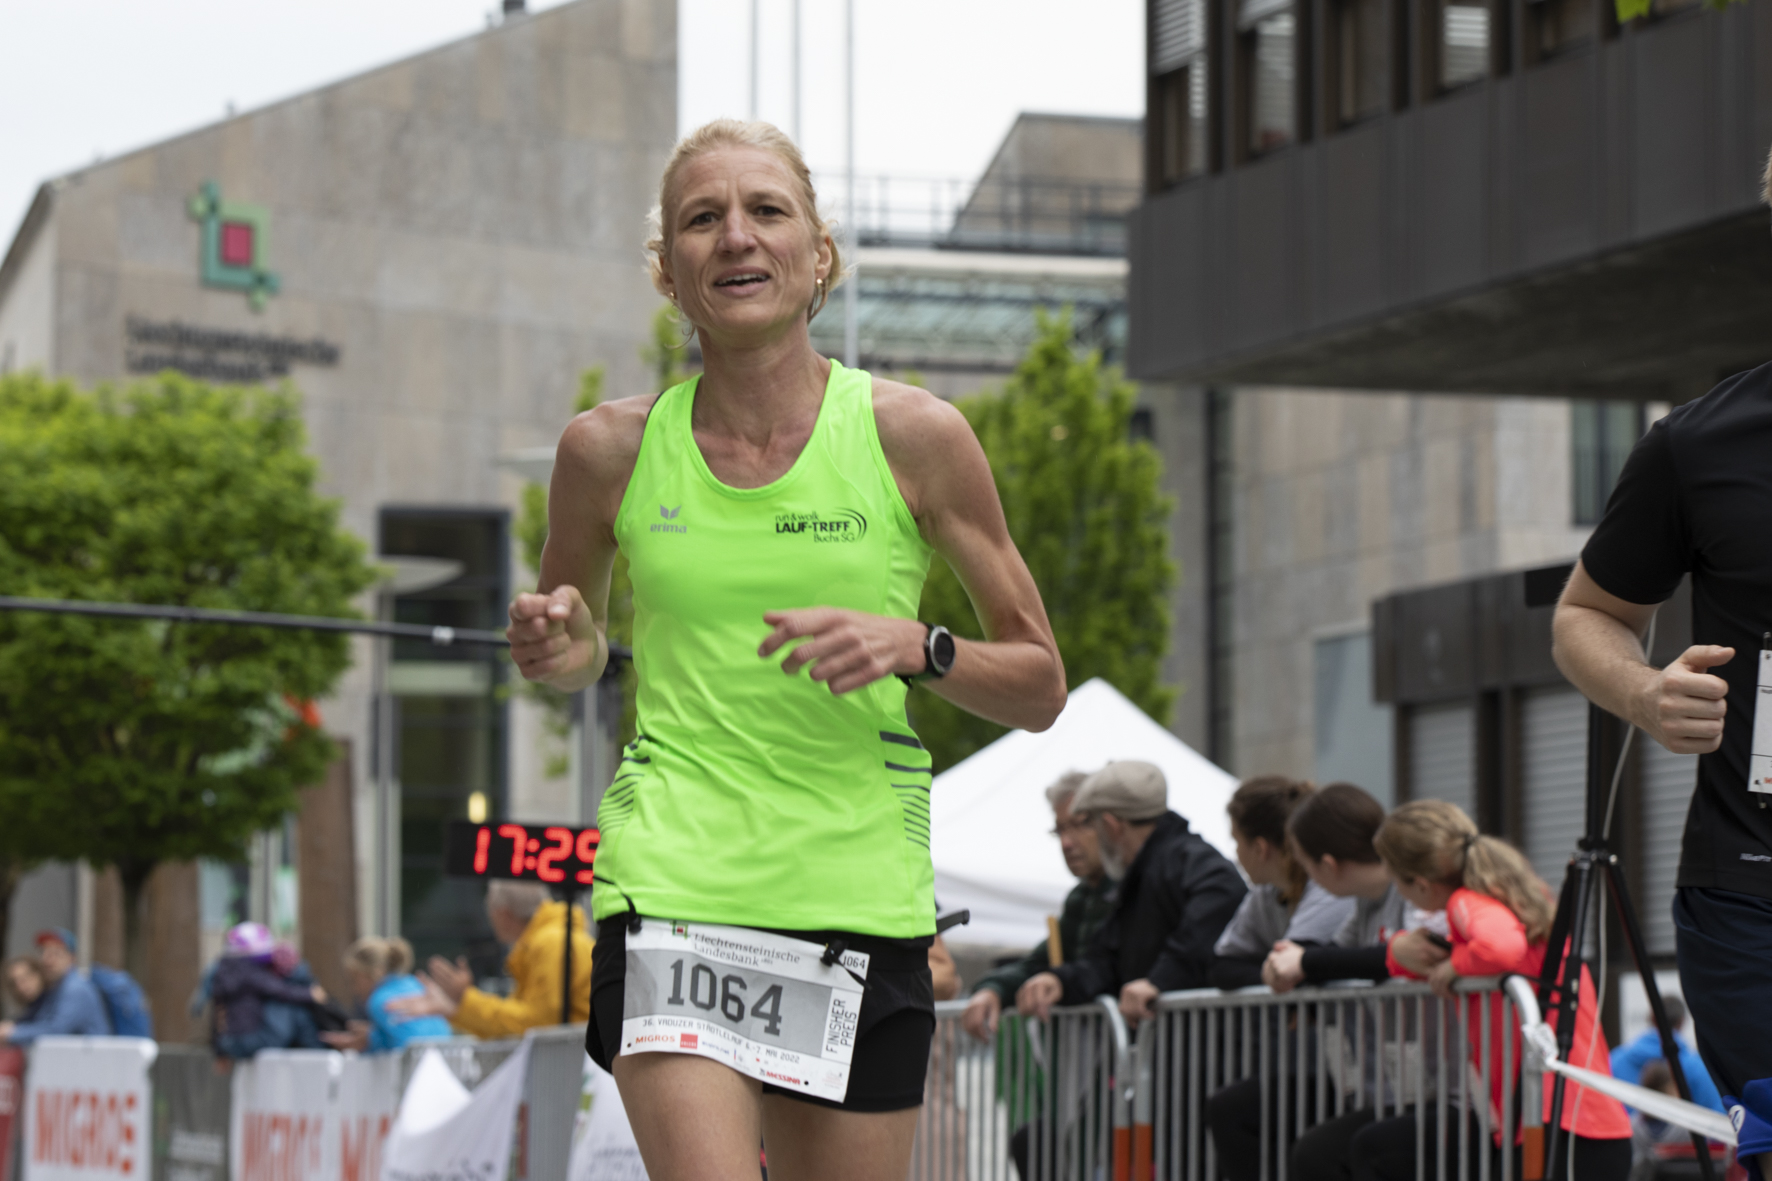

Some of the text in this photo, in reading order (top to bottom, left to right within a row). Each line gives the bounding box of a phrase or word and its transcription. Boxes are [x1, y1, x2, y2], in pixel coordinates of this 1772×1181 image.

[649, 522, 688, 534] erima
[775, 520, 851, 534] LAUF-TREFF
[813, 532, 856, 543] Buchs SG
[694, 933, 801, 965] Liechtensteinische
[694, 943, 760, 967] Landesbank
[842, 955, 866, 970] 1064
[667, 958, 783, 1037] 1064
[825, 998, 846, 1054] FINISHER
[840, 1011, 857, 1048] PREIS
[635, 1034, 676, 1044] MIGROS
[657, 1018, 694, 1028] VADUZER
[780, 1051, 800, 1065] 2022
